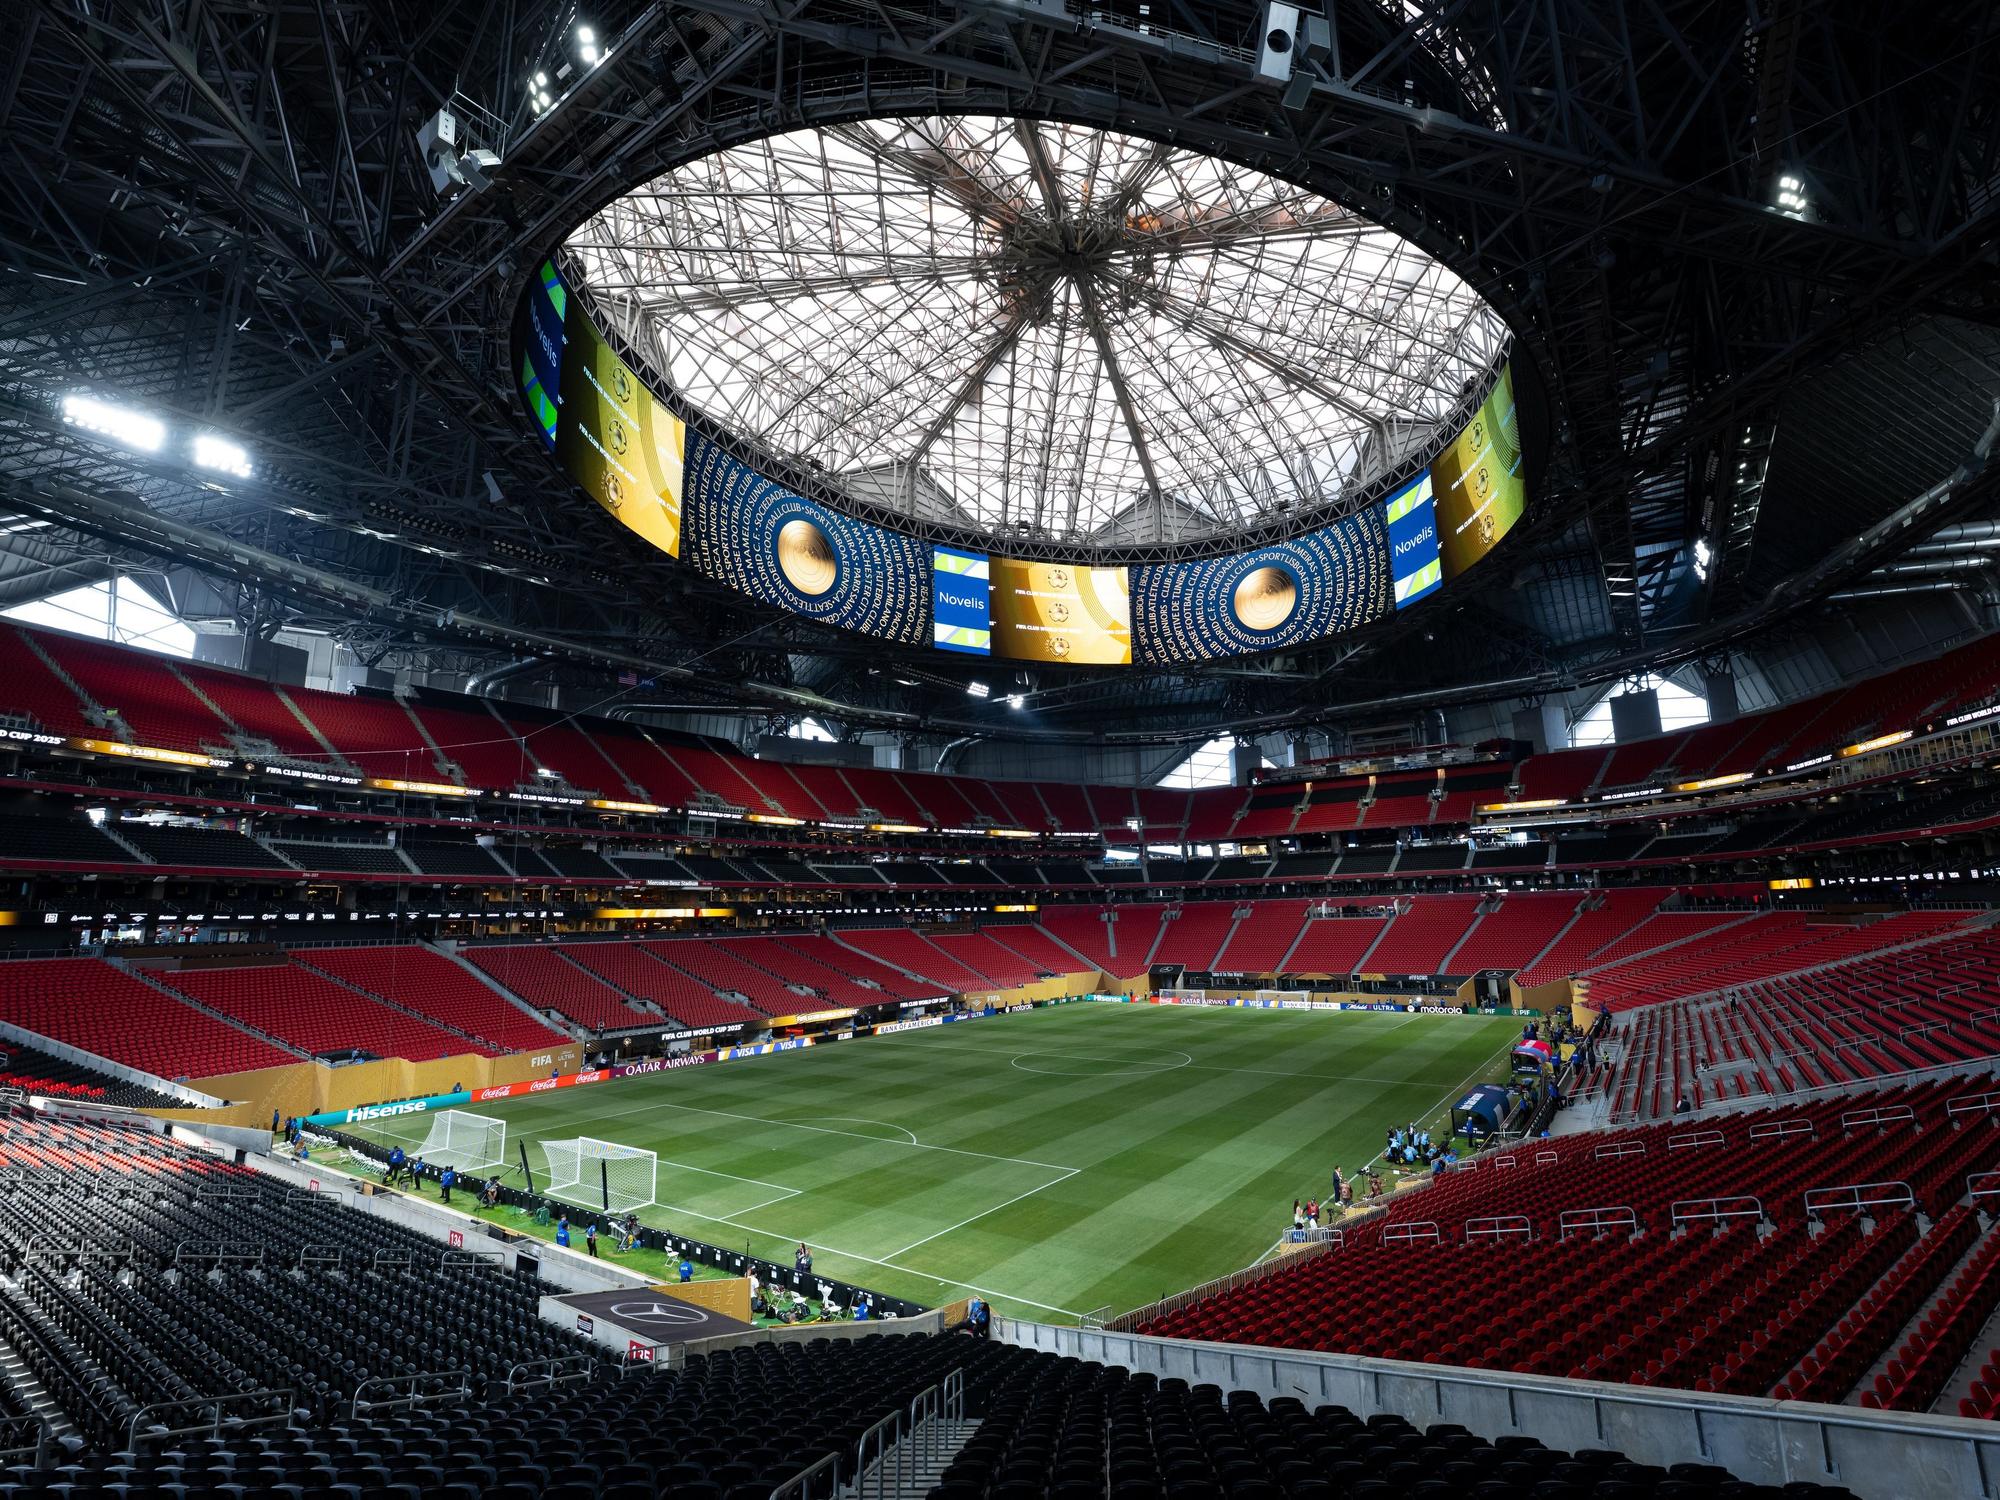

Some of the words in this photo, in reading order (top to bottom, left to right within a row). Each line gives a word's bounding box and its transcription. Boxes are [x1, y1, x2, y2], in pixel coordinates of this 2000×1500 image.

[530, 296, 557, 368] Novelis
[687, 471, 698, 505] LISBOA
[713, 467, 724, 493] CLUB
[709, 499, 719, 546] JUNIORS
[720, 501, 729, 517] DE
[730, 495, 743, 549] FOOTBALL
[738, 473, 753, 496] CLUB
[755, 489, 786, 528] SOCIEDADE
[781, 502, 802, 514] CLUB
[803, 505, 832, 529] SPORT
[688, 506, 697, 542] SPORT
[741, 504, 754, 569] MAMELODI
[763, 507, 784, 554] FOOTBALL
[1372, 522, 1384, 545] CLUB
[701, 540, 712, 570] CLUB
[720, 517, 733, 571] SPORTIVE
[827, 510, 860, 561] PALMEIRAS
[851, 567, 861, 594] PARIS
[828, 526, 849, 560] LISBOA
[865, 533, 883, 565] MIAMI
[1330, 524, 1356, 579] ERNAZIONALE
[1345, 523, 1359, 544] CLUB
[1354, 543, 1363, 557] DE
[1395, 525, 1433, 558] Novelis
[712, 547, 725, 580] BOCA
[851, 527, 872, 598] MANCHESTER
[873, 527, 895, 593] ERNAZIONALE
[889, 538, 901, 562] CLUB
[896, 563, 905, 576] DE
[916, 557, 927, 580] CLUB
[1235, 557, 1256, 575] CLUB
[1258, 553, 1286, 562] SPORT
[1283, 541, 1318, 573] PALMEIRAS
[1313, 576, 1322, 601] PARIS
[1284, 554, 1307, 579] LISBOA
[1308, 539, 1333, 599] MANCHESTER
[1323, 535, 1341, 562] MIAMI
[1335, 564, 1345, 607] FUTEBOL
[1367, 544, 1378, 599] BOTAFOGO
[1379, 549, 1388, 573] REAL
[753, 553, 780, 600] MADRID
[765, 553, 800, 606] SOUNDERS
[832, 567, 850, 603] BENFICA
[871, 570, 884, 610] FUTEBOL
[1161, 577, 1172, 598] CLUB
[1188, 565, 1202, 586] CLUB
[1208, 557, 1238, 601] SOCIEDADE
[798, 599, 835, 612] SEATTLE
[856, 597, 870, 620] CITY
[907, 573, 918, 623] BOTAFOGO
[919, 586, 929, 605] REAL
[939, 591, 985, 610] Novelis
[1171, 600, 1180, 612] DE
[1183, 588, 1194, 630] FOOTBALL
[1219, 573, 1238, 617] FOOTBALL
[1294, 582, 1310, 621] BENFICA
[1342, 580, 1356, 619] MILANO
[1376, 575, 1388, 613] MADRID
[879, 592, 895, 628] MILANO
[912, 607, 927, 641] MADRID
[1195, 588, 1211, 639] MAMELODI
[1318, 600, 1332, 625] CITY
[1172, 612, 1189, 650] SPORTIVE
[1211, 620, 1239, 650] MADRID
[1221, 615, 1261, 645] SOUNDERS
[1260, 622, 1298, 645] SEATTLE
[1153, 637, 1167, 659] CLUB
[1166, 637, 1182, 660] BOCA
[1958, 714, 1972, 723] CLUB
[1972, 708, 1992, 719] WORLD
[9, 731, 32, 740] CUP
[266, 766, 282, 775] FIFA
[283, 769, 301, 777] CLUB
[302, 771, 326, 780] WORLD
[1420, 1006, 1463, 1014] motorola
[661, 1032, 676, 1041] FIFA
[676, 1030, 692, 1039] CLUB
[693, 1027, 714, 1037] WORLD
[714, 1026, 728, 1034] CUP
[880, 1025, 899, 1034] BANK
[900, 1022, 907, 1030] OF
[907, 1019, 934, 1029] AMERICA
[531, 1054, 553, 1067] FIFA
[736, 1046, 755, 1058] VISA
[780, 1040, 797, 1051] VISA
[575, 1071, 601, 1085] Coca-Cola
[625, 1061, 661, 1076] QATAR
[664, 1054, 705, 1070] AIRWAYS
[481, 1085, 512, 1100] Coca-Cola
[530, 1078, 558, 1092] Coca-Cola
[346, 1101, 427, 1123] Hisense
[450, 1232, 462, 1248] 136
